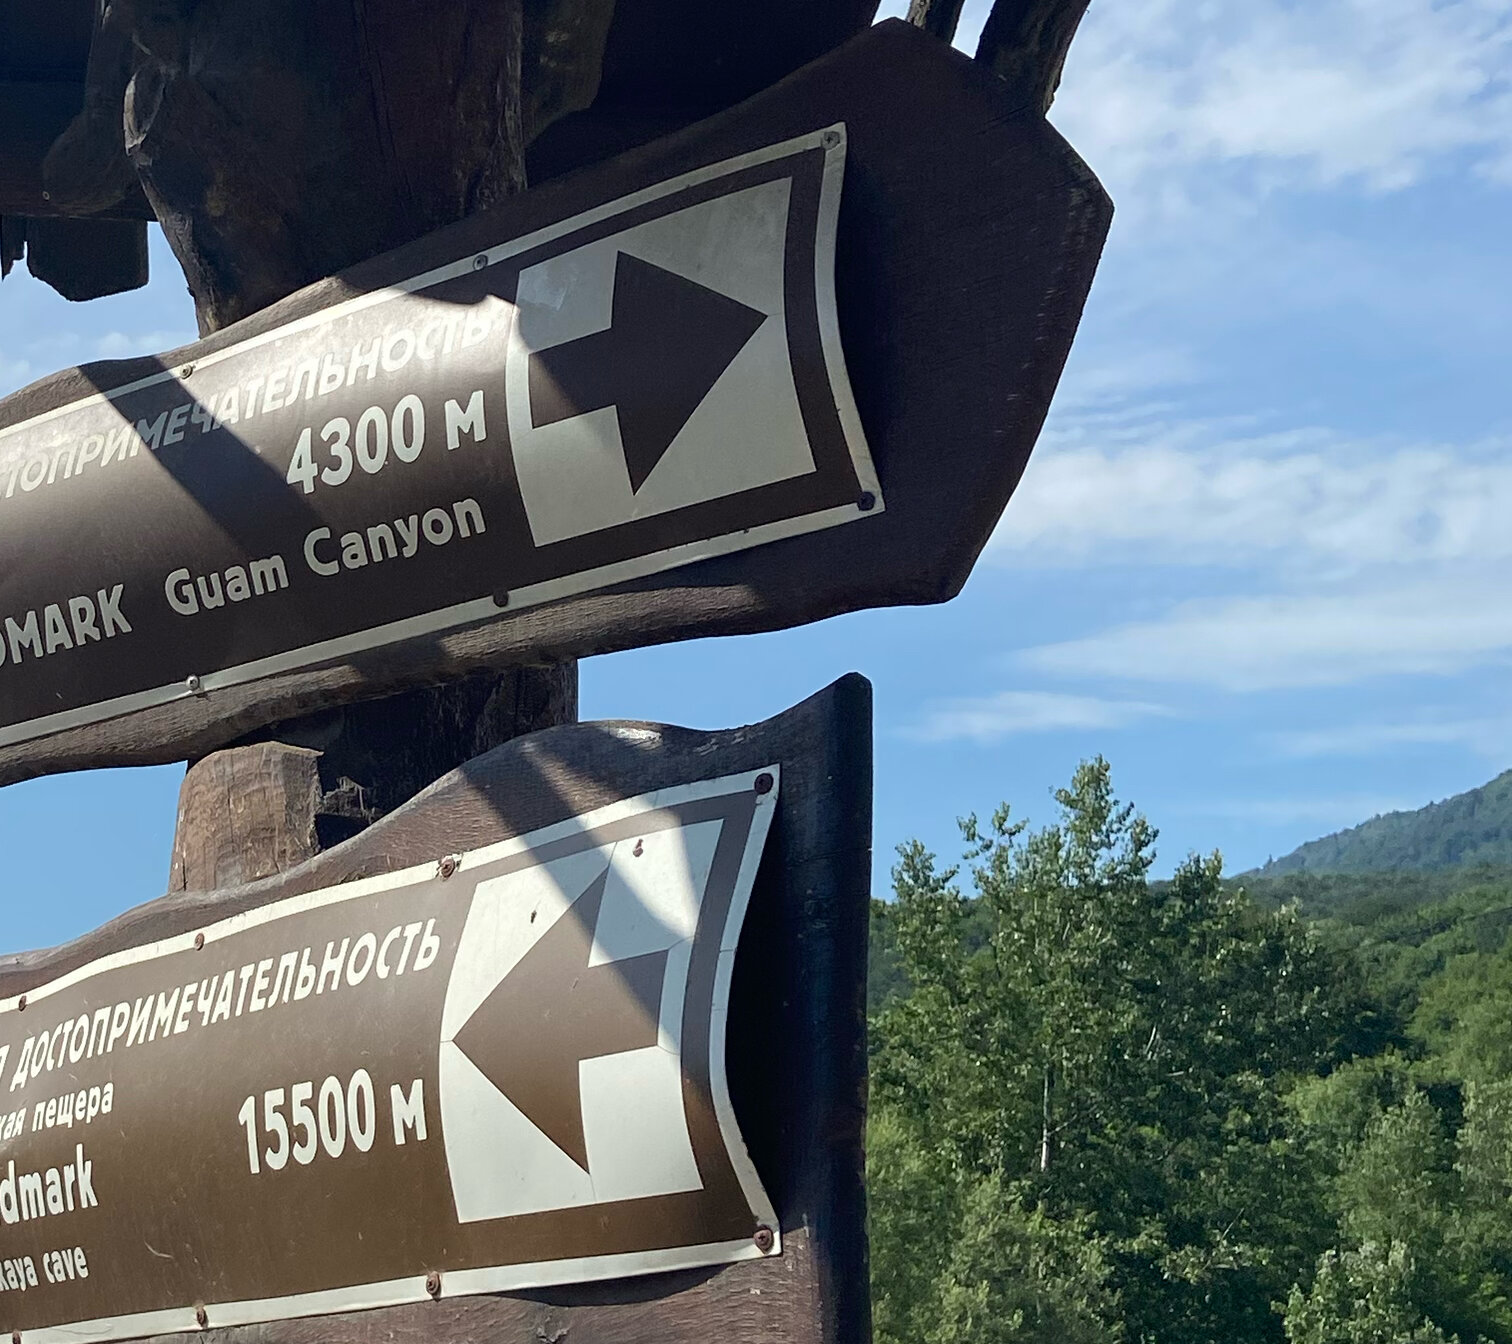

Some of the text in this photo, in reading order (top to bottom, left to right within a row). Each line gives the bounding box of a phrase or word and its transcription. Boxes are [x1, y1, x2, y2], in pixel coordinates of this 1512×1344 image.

[286, 393, 425, 495] 4300
[164, 549, 288, 617] Guam
[303, 497, 487, 577] Canyon
[11, 918, 441, 1090] ДОСТОПРИМЕЧАТЕЛЬНОСТЬ
[31, 1083, 114, 1132] пещера
[238, 1068, 376, 1174] 15500
[44, 1245, 89, 1284] cave
